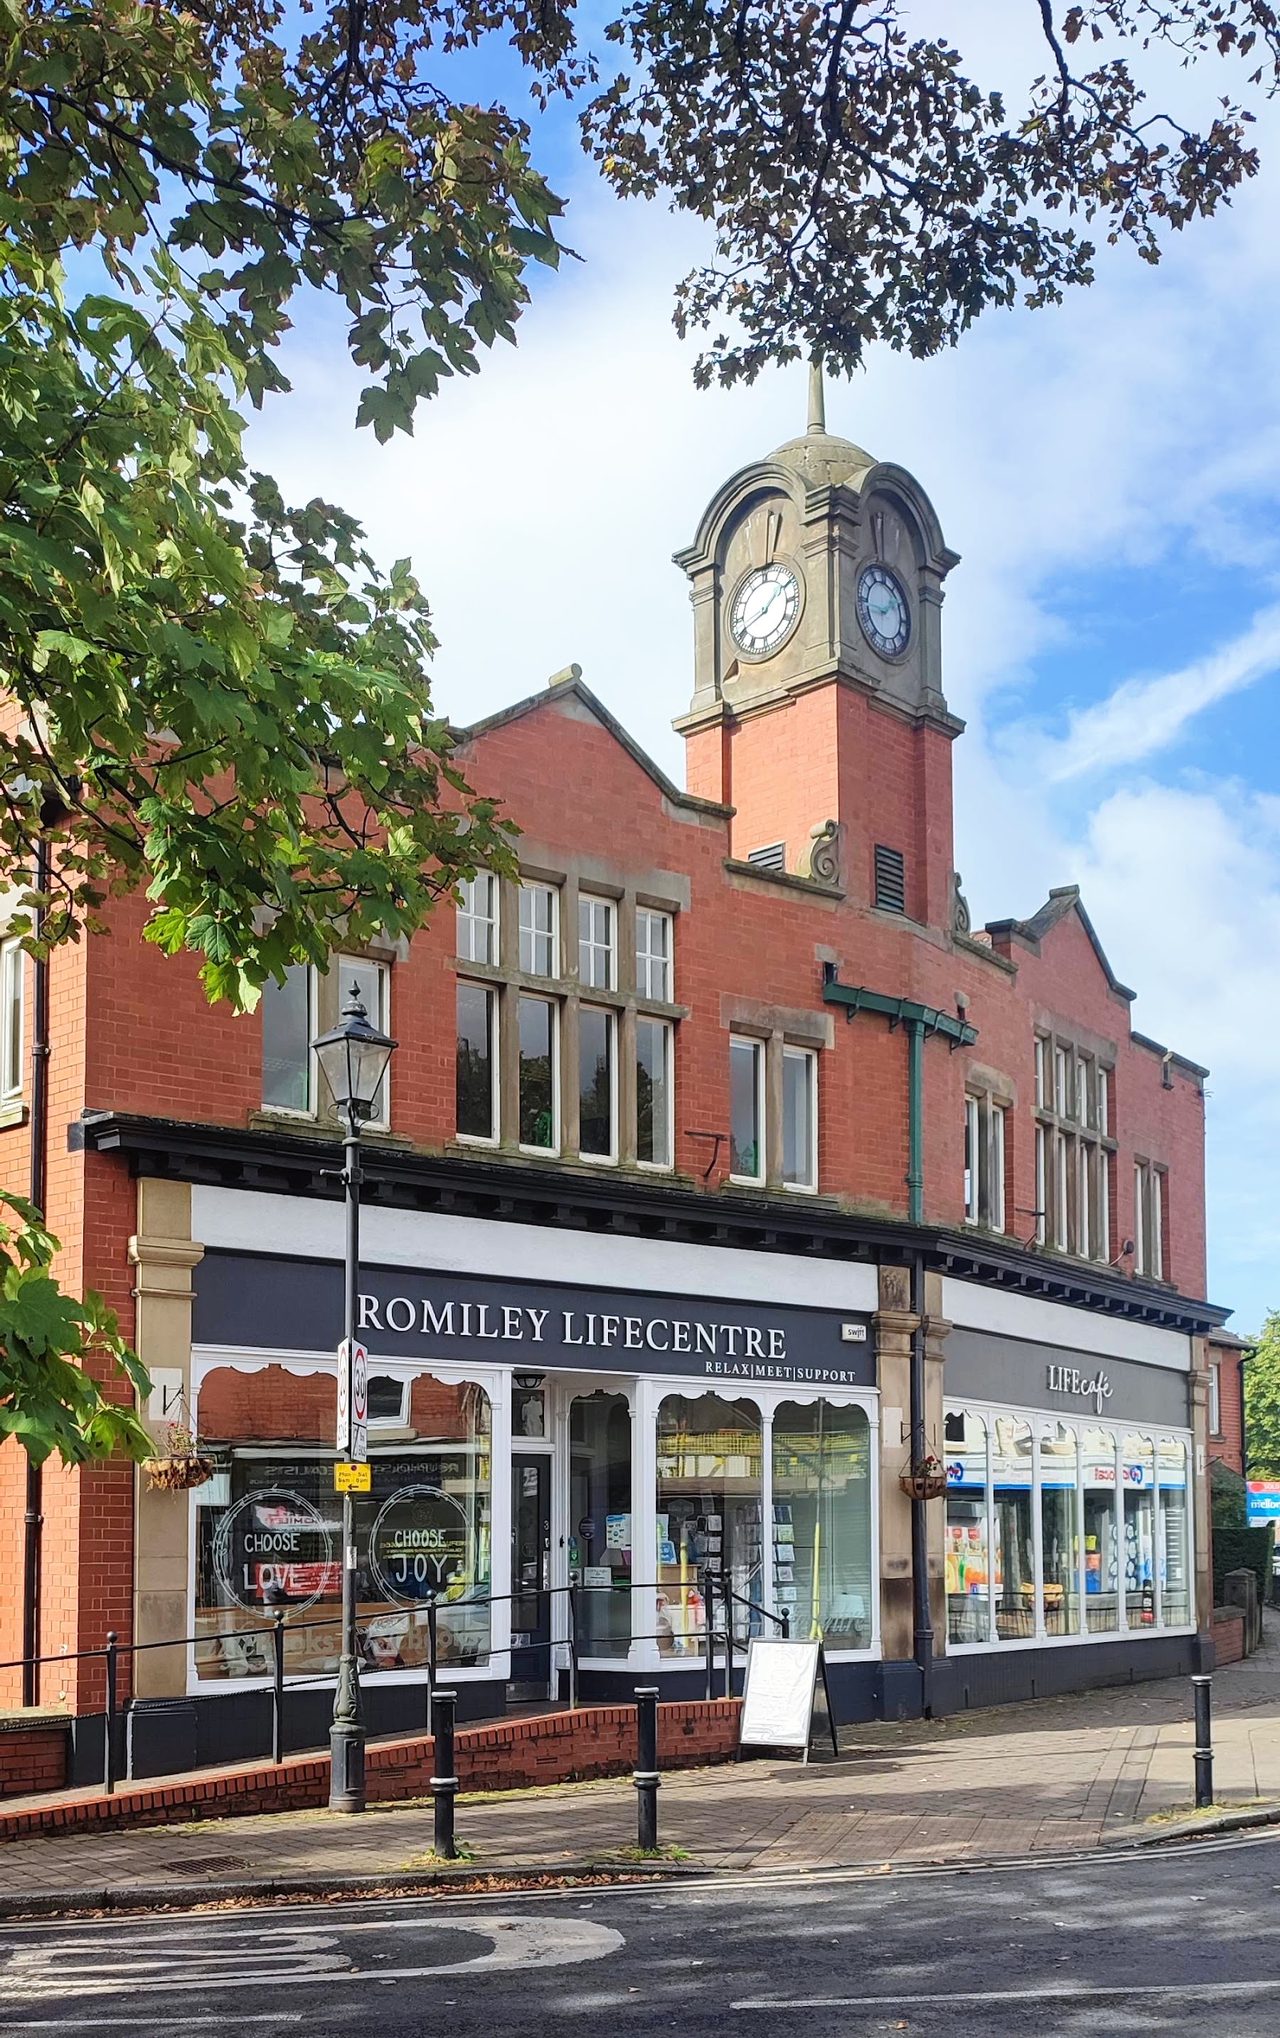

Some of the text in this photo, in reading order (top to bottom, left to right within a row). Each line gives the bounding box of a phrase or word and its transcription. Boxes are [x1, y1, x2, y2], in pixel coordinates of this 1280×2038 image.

[358, 1294, 787, 1359] ROMILEY LIFECENTRE
[244, 1533, 300, 1552] CHOOSE
[394, 1529, 447, 1547] CHOOSE
[243, 1563, 300, 1590] LOVE
[395, 1554, 448, 1583] JOY
